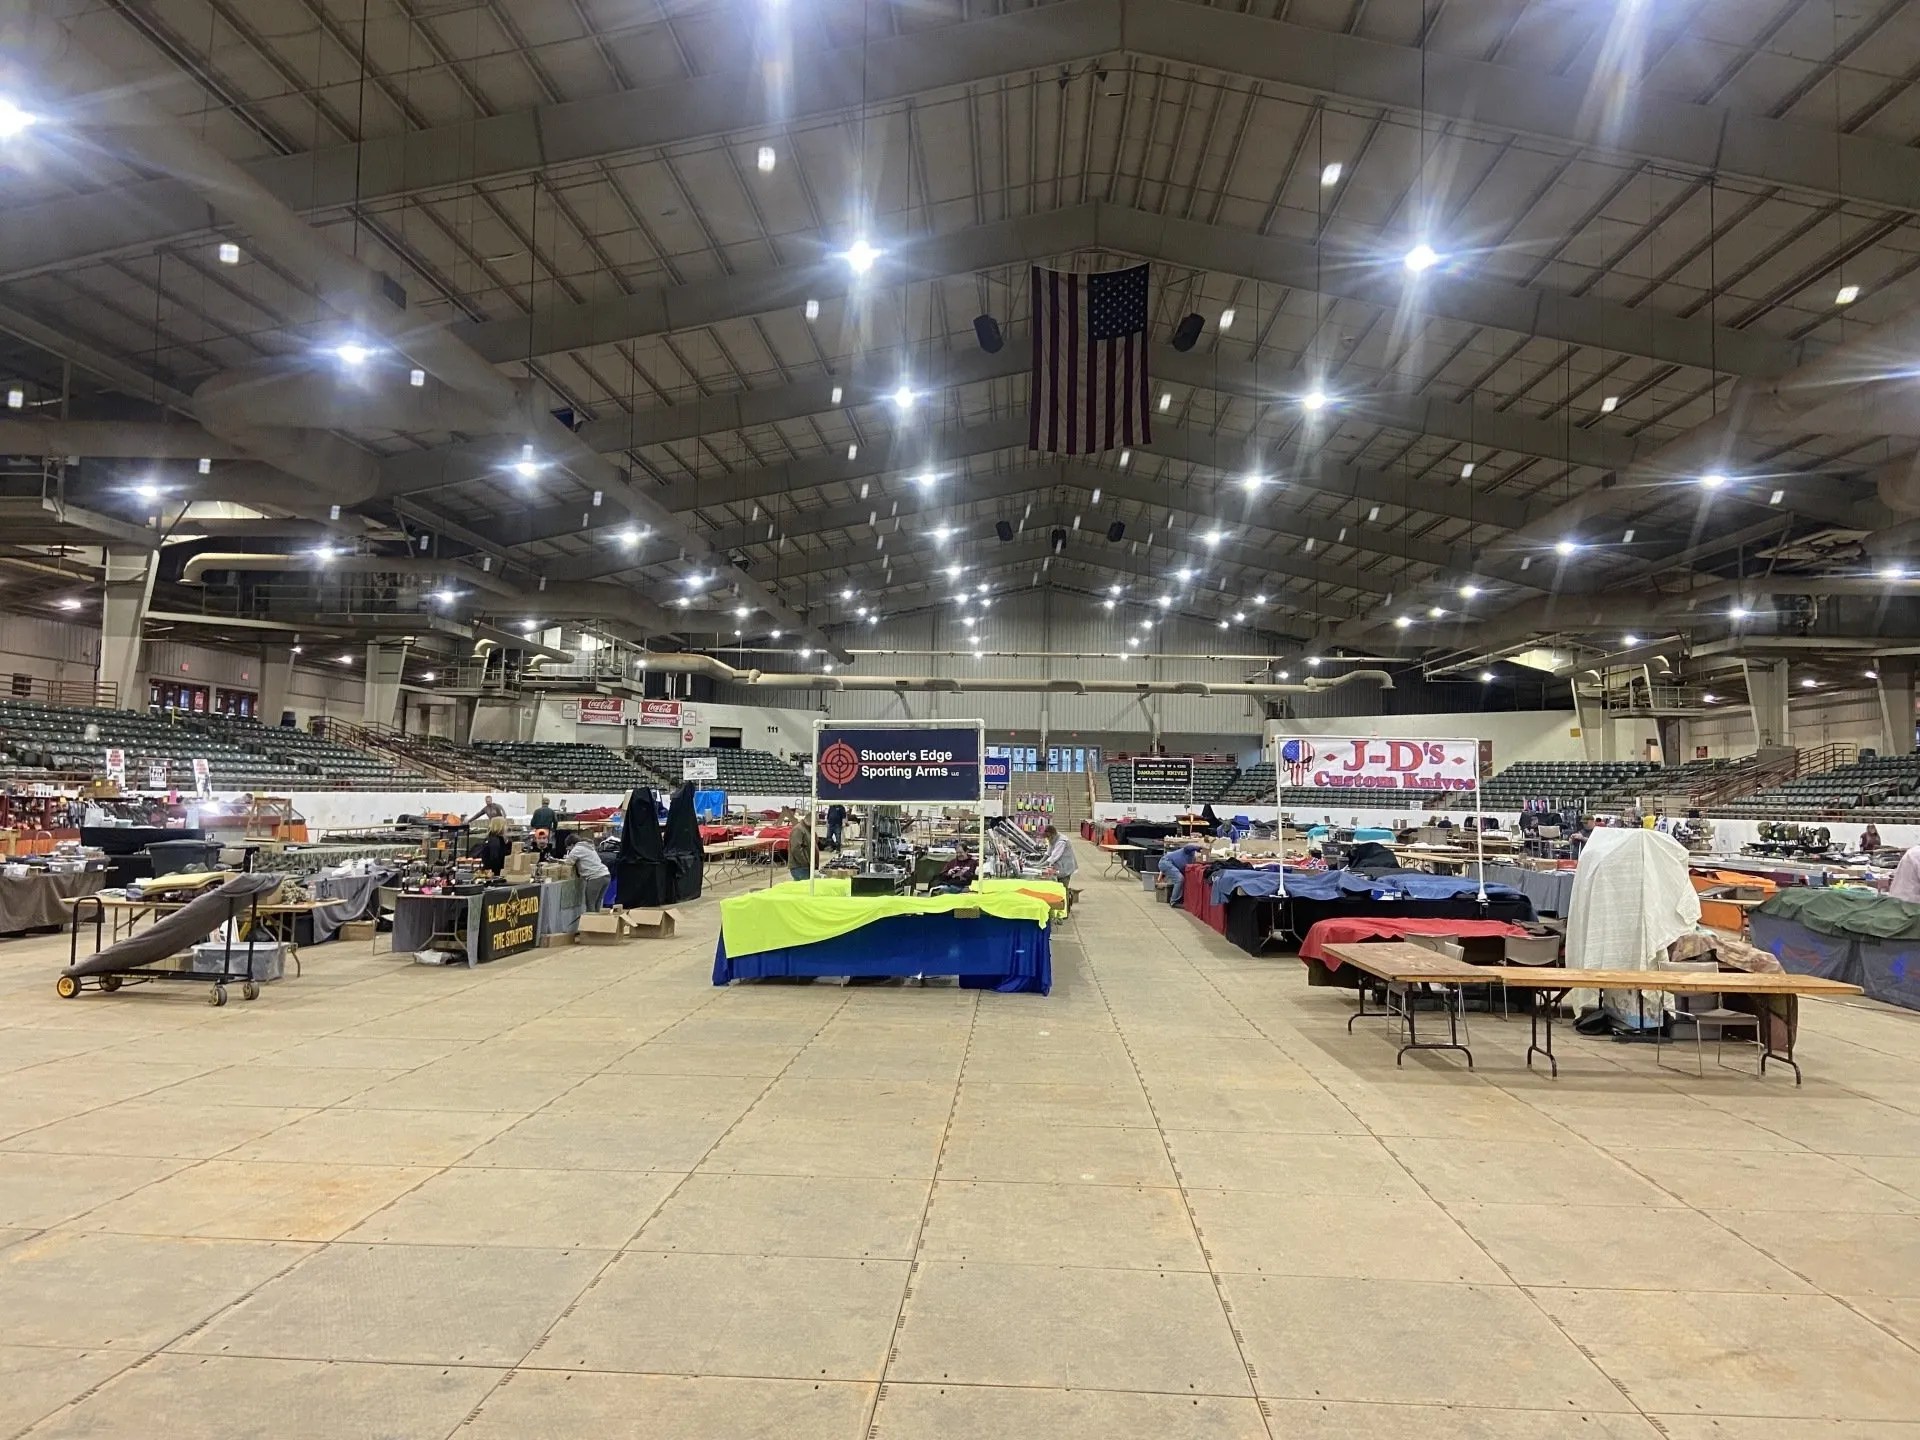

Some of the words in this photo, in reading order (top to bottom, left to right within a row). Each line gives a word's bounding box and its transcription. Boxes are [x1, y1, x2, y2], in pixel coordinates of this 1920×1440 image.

[625, 718, 638, 726] 112
[860, 749, 917, 761] Shooter's
[920, 749, 953, 763] Edge
[1343, 740, 1446, 772] J-D's
[861, 765, 912, 779] Sporting
[915, 765, 948, 777] Arms
[1313, 770, 1398, 788] Custom
[1402, 771, 1476, 791] Knives
[488, 904, 507, 923] BLACK
[519, 896, 539, 916] BEARD
